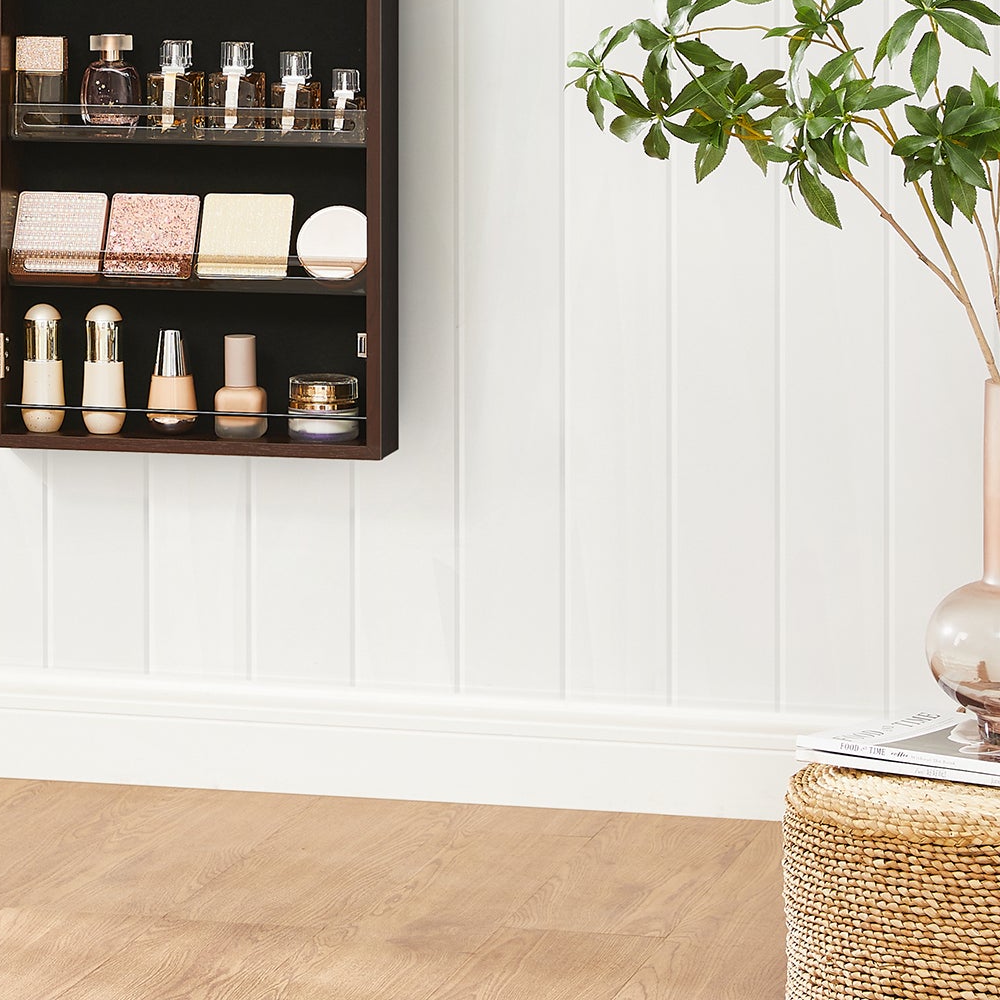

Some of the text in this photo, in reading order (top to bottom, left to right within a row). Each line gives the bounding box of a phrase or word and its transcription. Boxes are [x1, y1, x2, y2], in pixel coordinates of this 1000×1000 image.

[890, 712, 941, 728] TIME
[839, 742, 860, 752] FOOD
[869, 748, 886, 756] TIME
